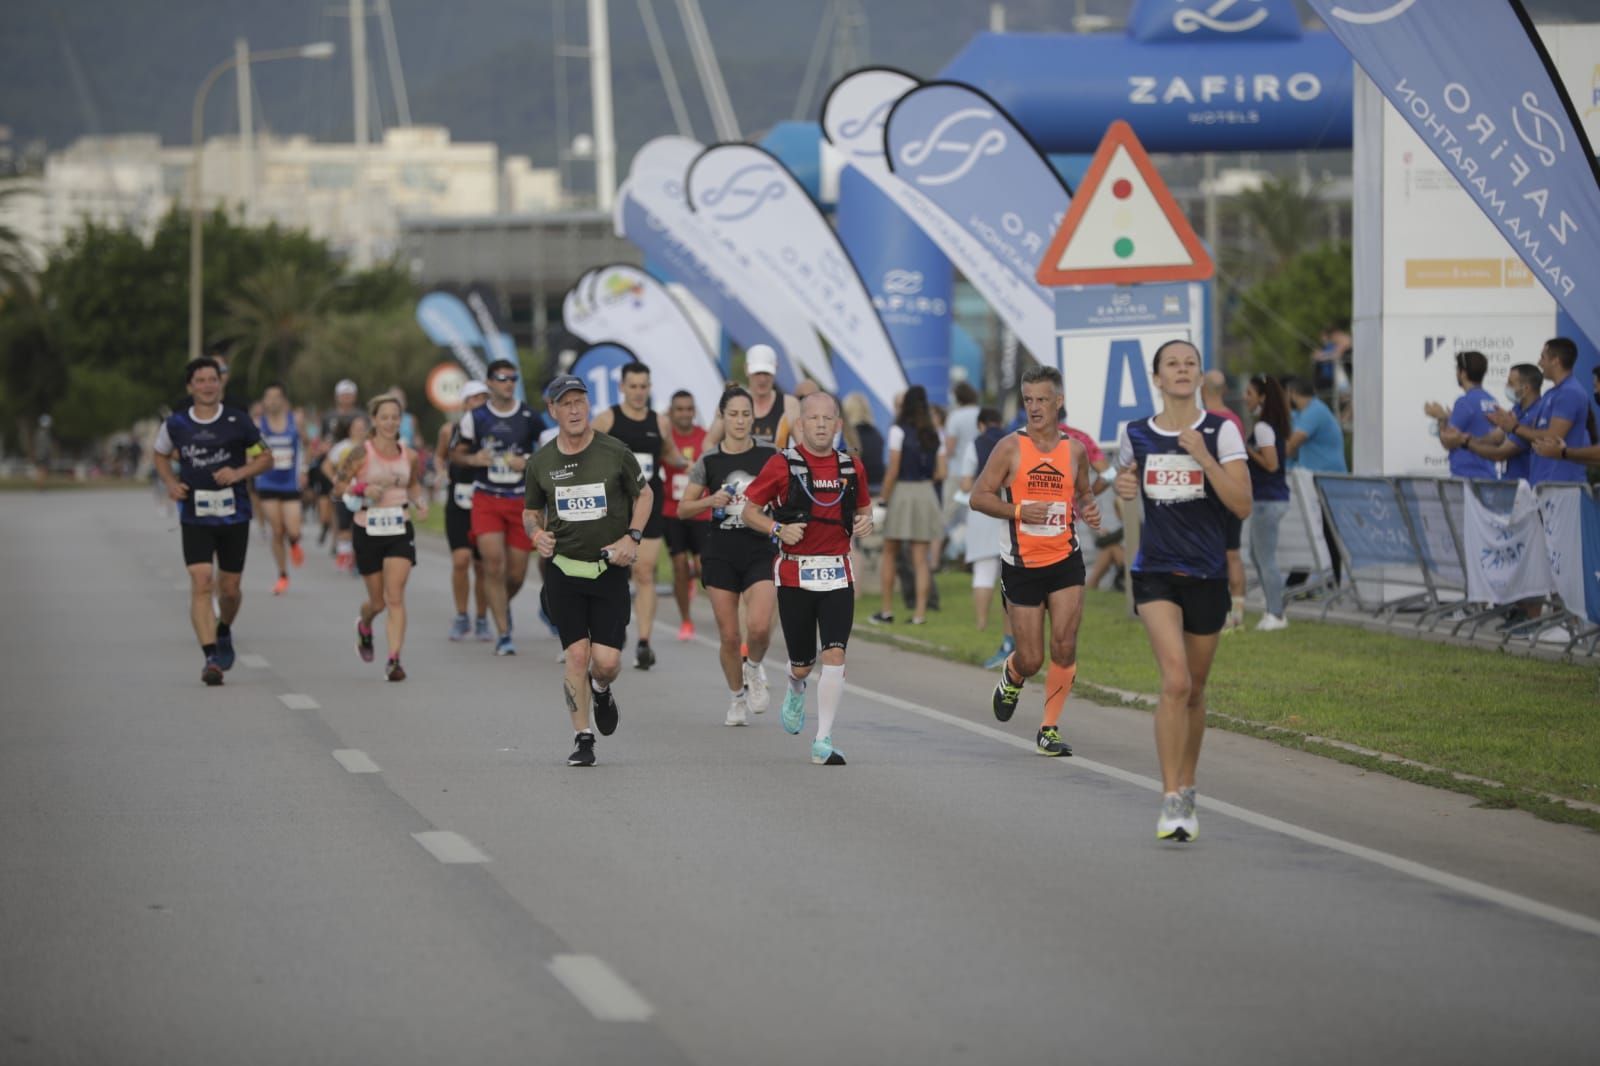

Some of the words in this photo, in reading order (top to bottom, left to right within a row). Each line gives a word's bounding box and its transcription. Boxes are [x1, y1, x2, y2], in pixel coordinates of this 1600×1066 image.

[1098, 339, 1157, 443] A
[1029, 474, 1062, 482] HOLZBAU
[1155, 471, 1191, 485] 926
[1028, 481, 1049, 489] PETER
[567, 497, 596, 510] 603
[811, 568, 836, 580] 163
